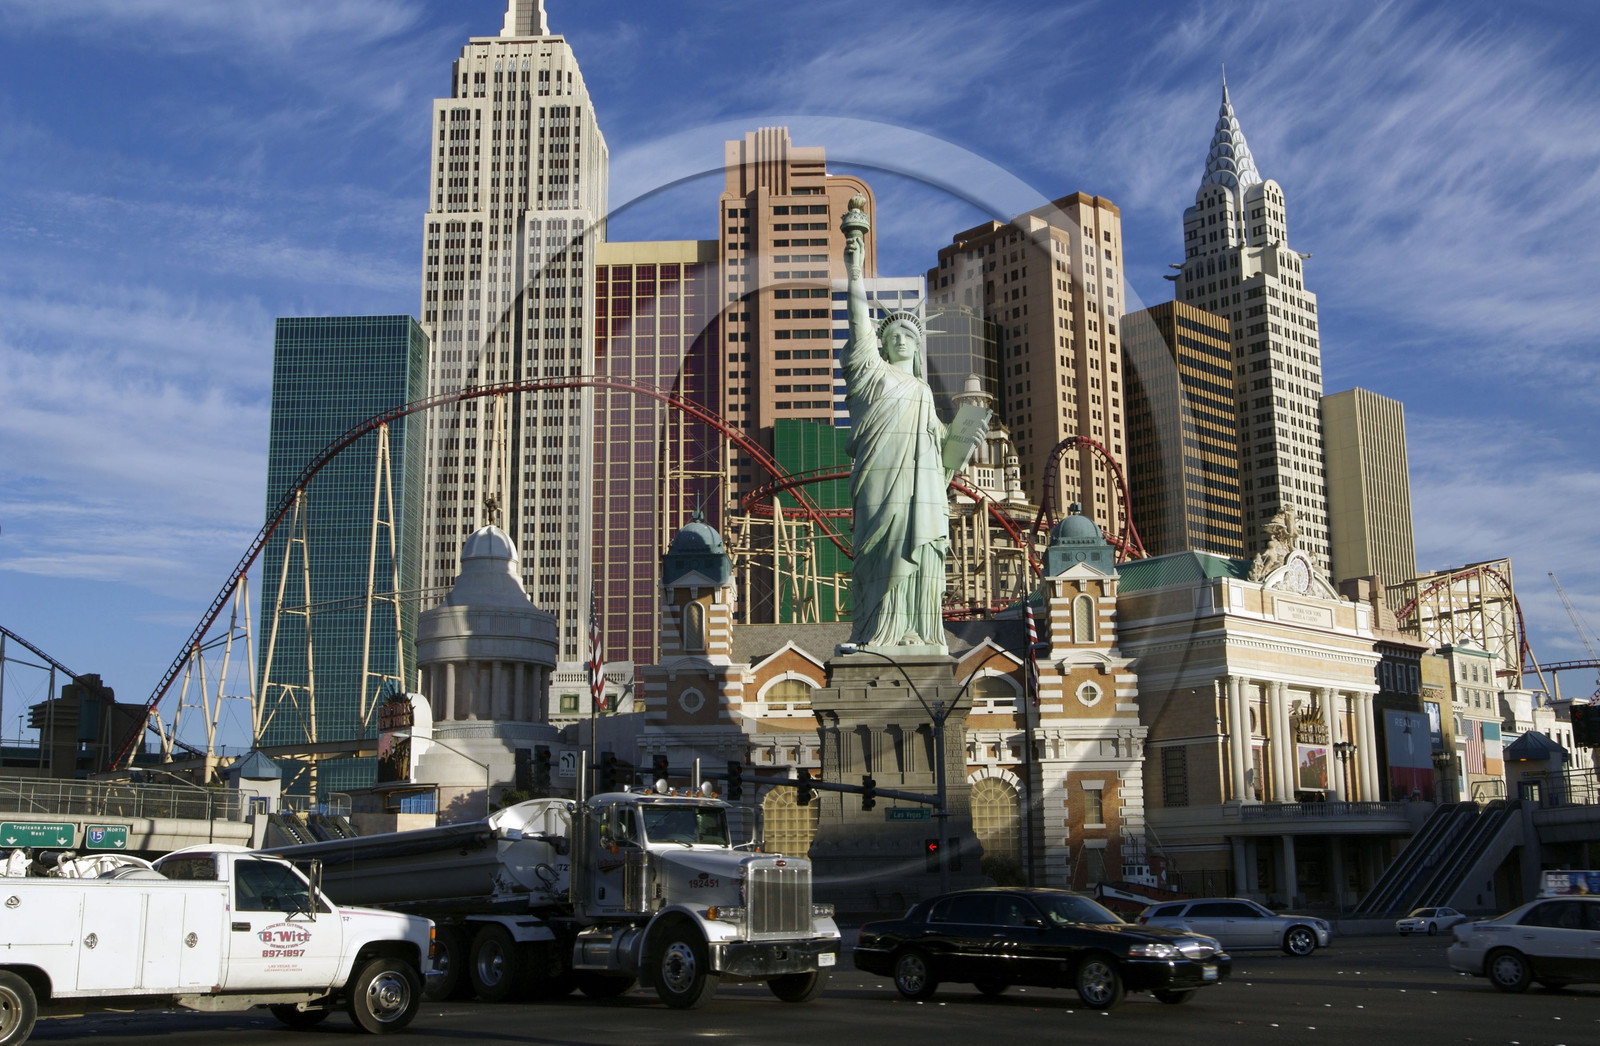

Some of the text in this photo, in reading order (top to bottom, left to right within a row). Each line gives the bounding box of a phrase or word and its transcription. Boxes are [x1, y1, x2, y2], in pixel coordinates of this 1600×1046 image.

[906, 811, 922, 819] Vegas
[12, 824, 41, 832] Tropicana
[92, 831, 103, 840] 15
[688, 880, 720, 889] 192451
[1547, 880, 1570, 888] MAN
[276, 930, 312, 942] Witt
[262, 949, 306, 958] 897-1897
